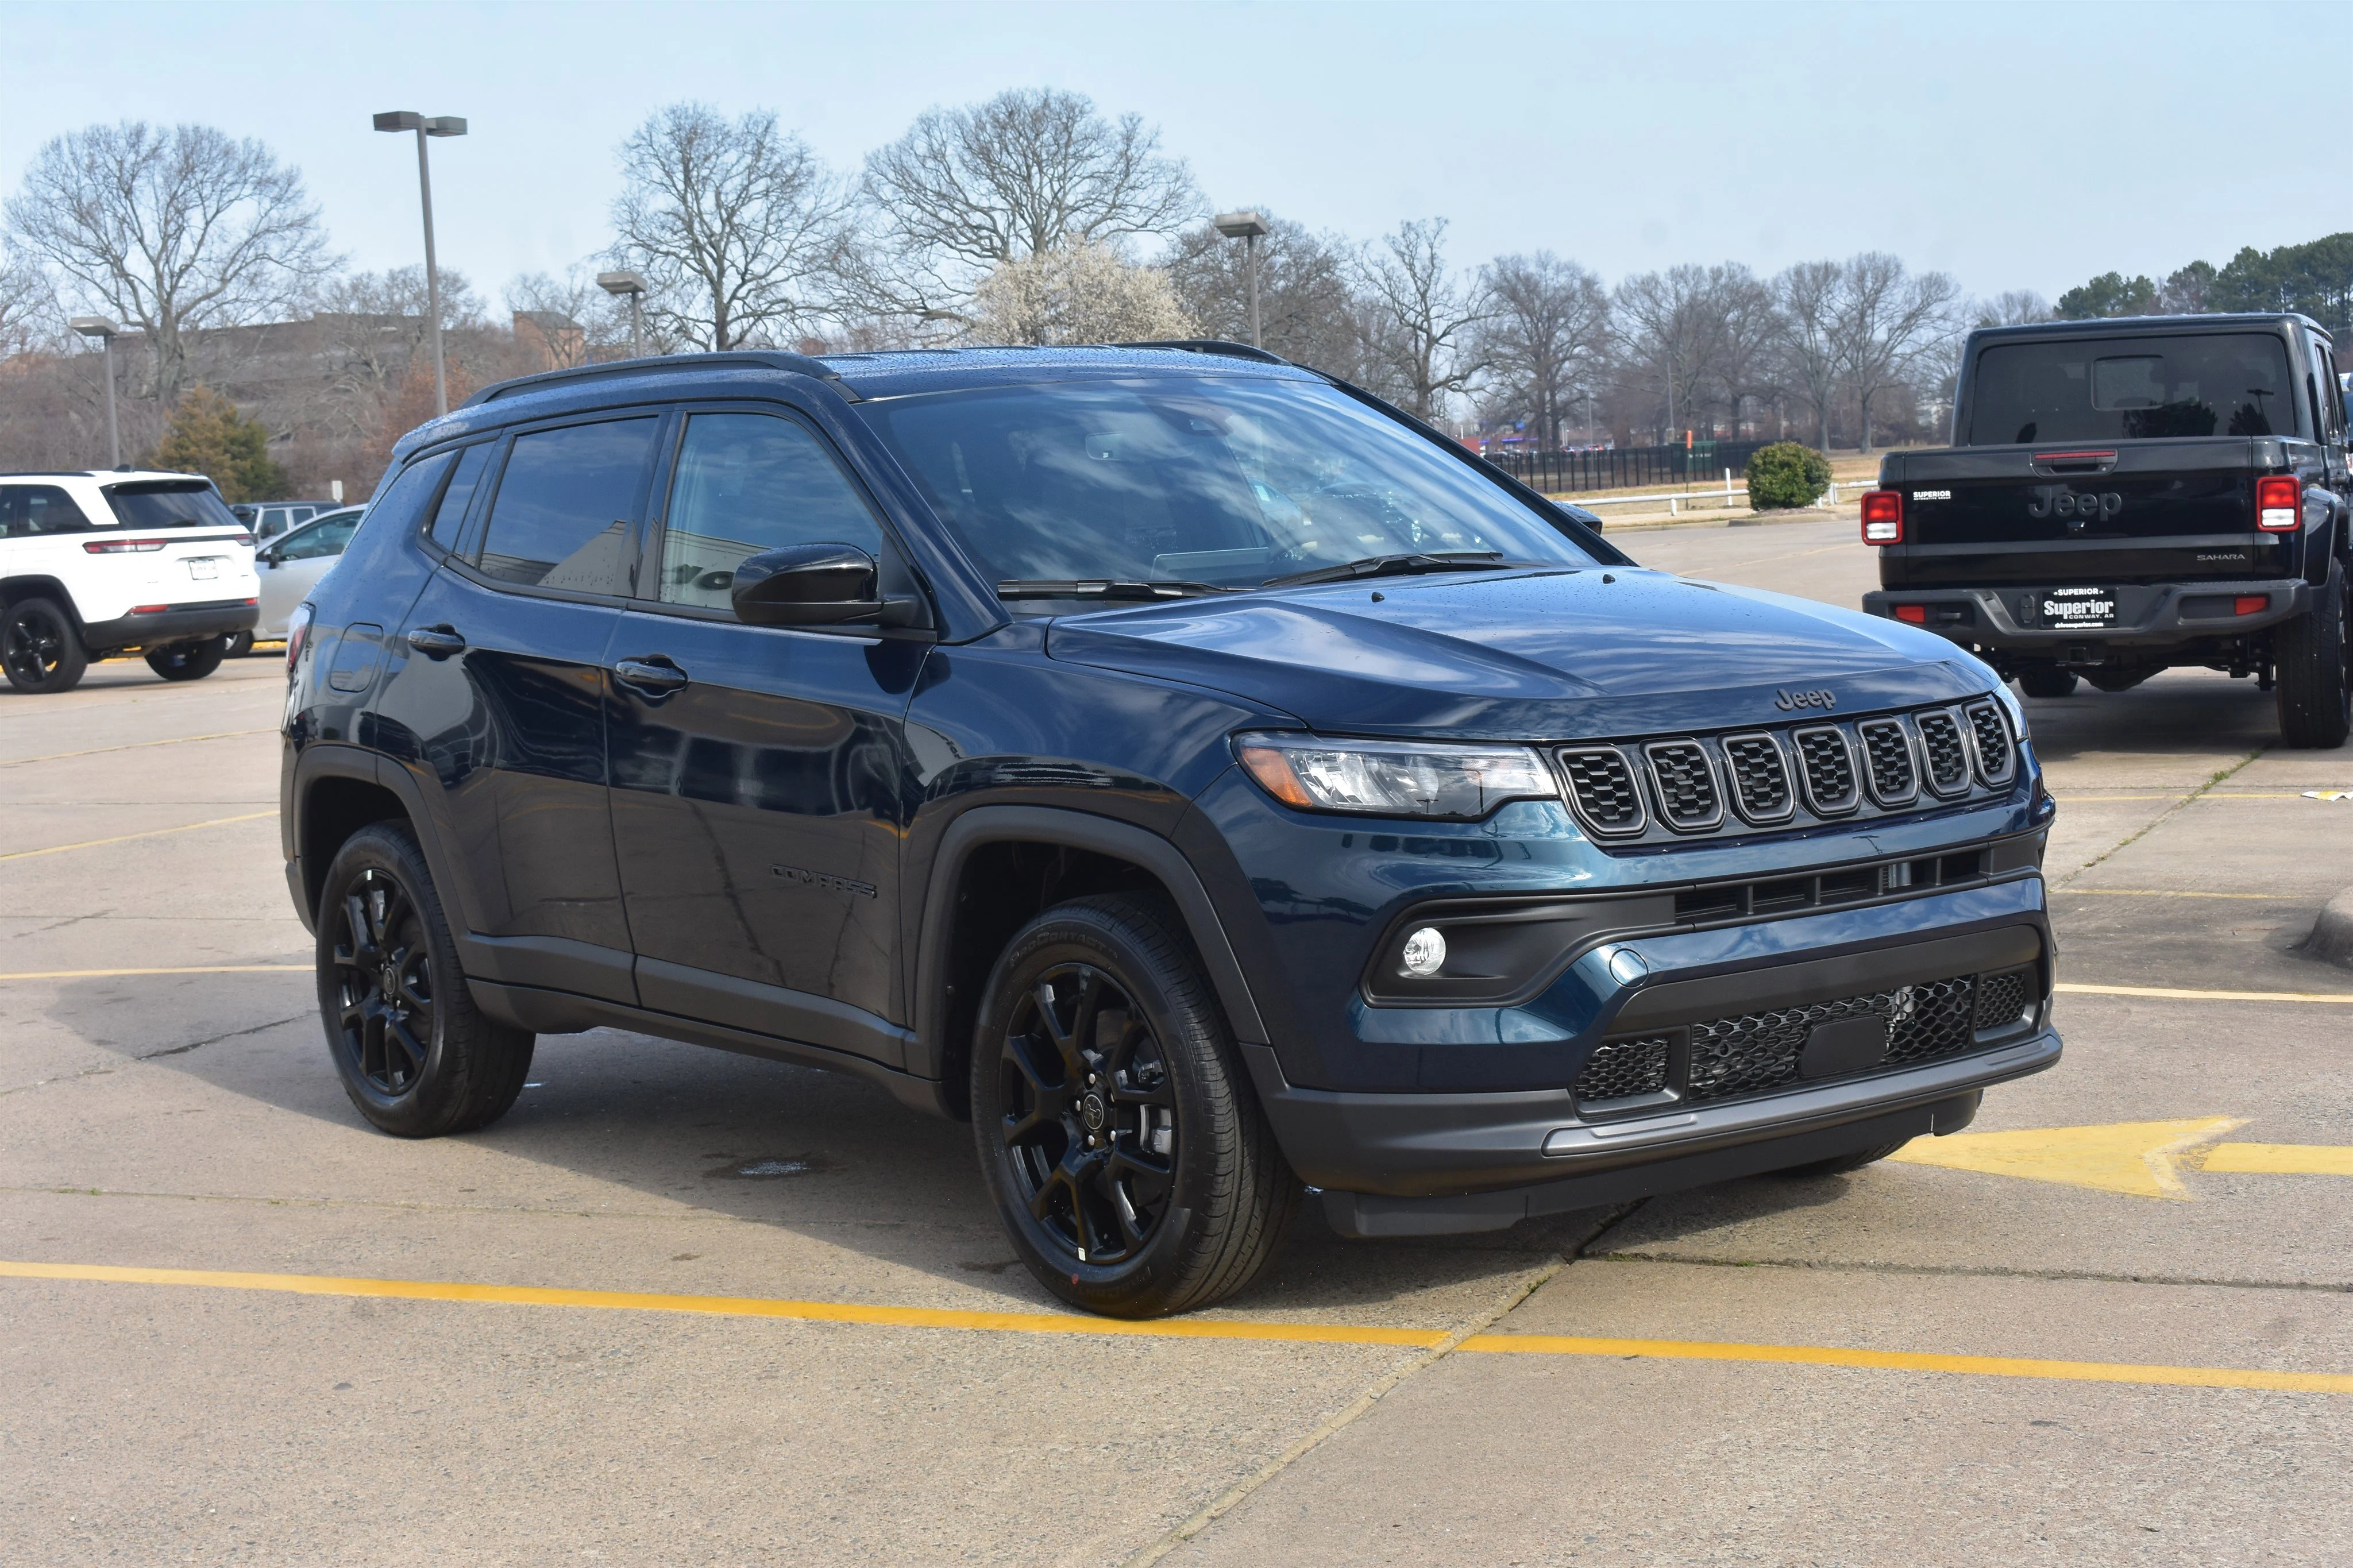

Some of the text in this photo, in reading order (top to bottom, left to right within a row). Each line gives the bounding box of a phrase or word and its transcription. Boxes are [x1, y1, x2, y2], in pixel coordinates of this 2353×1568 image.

[2028, 487, 2121, 522] Jeep
[2044, 599, 2114, 619] Superior
[1775, 689, 1837, 712] Jeep
[770, 863, 877, 899] COMPASS
